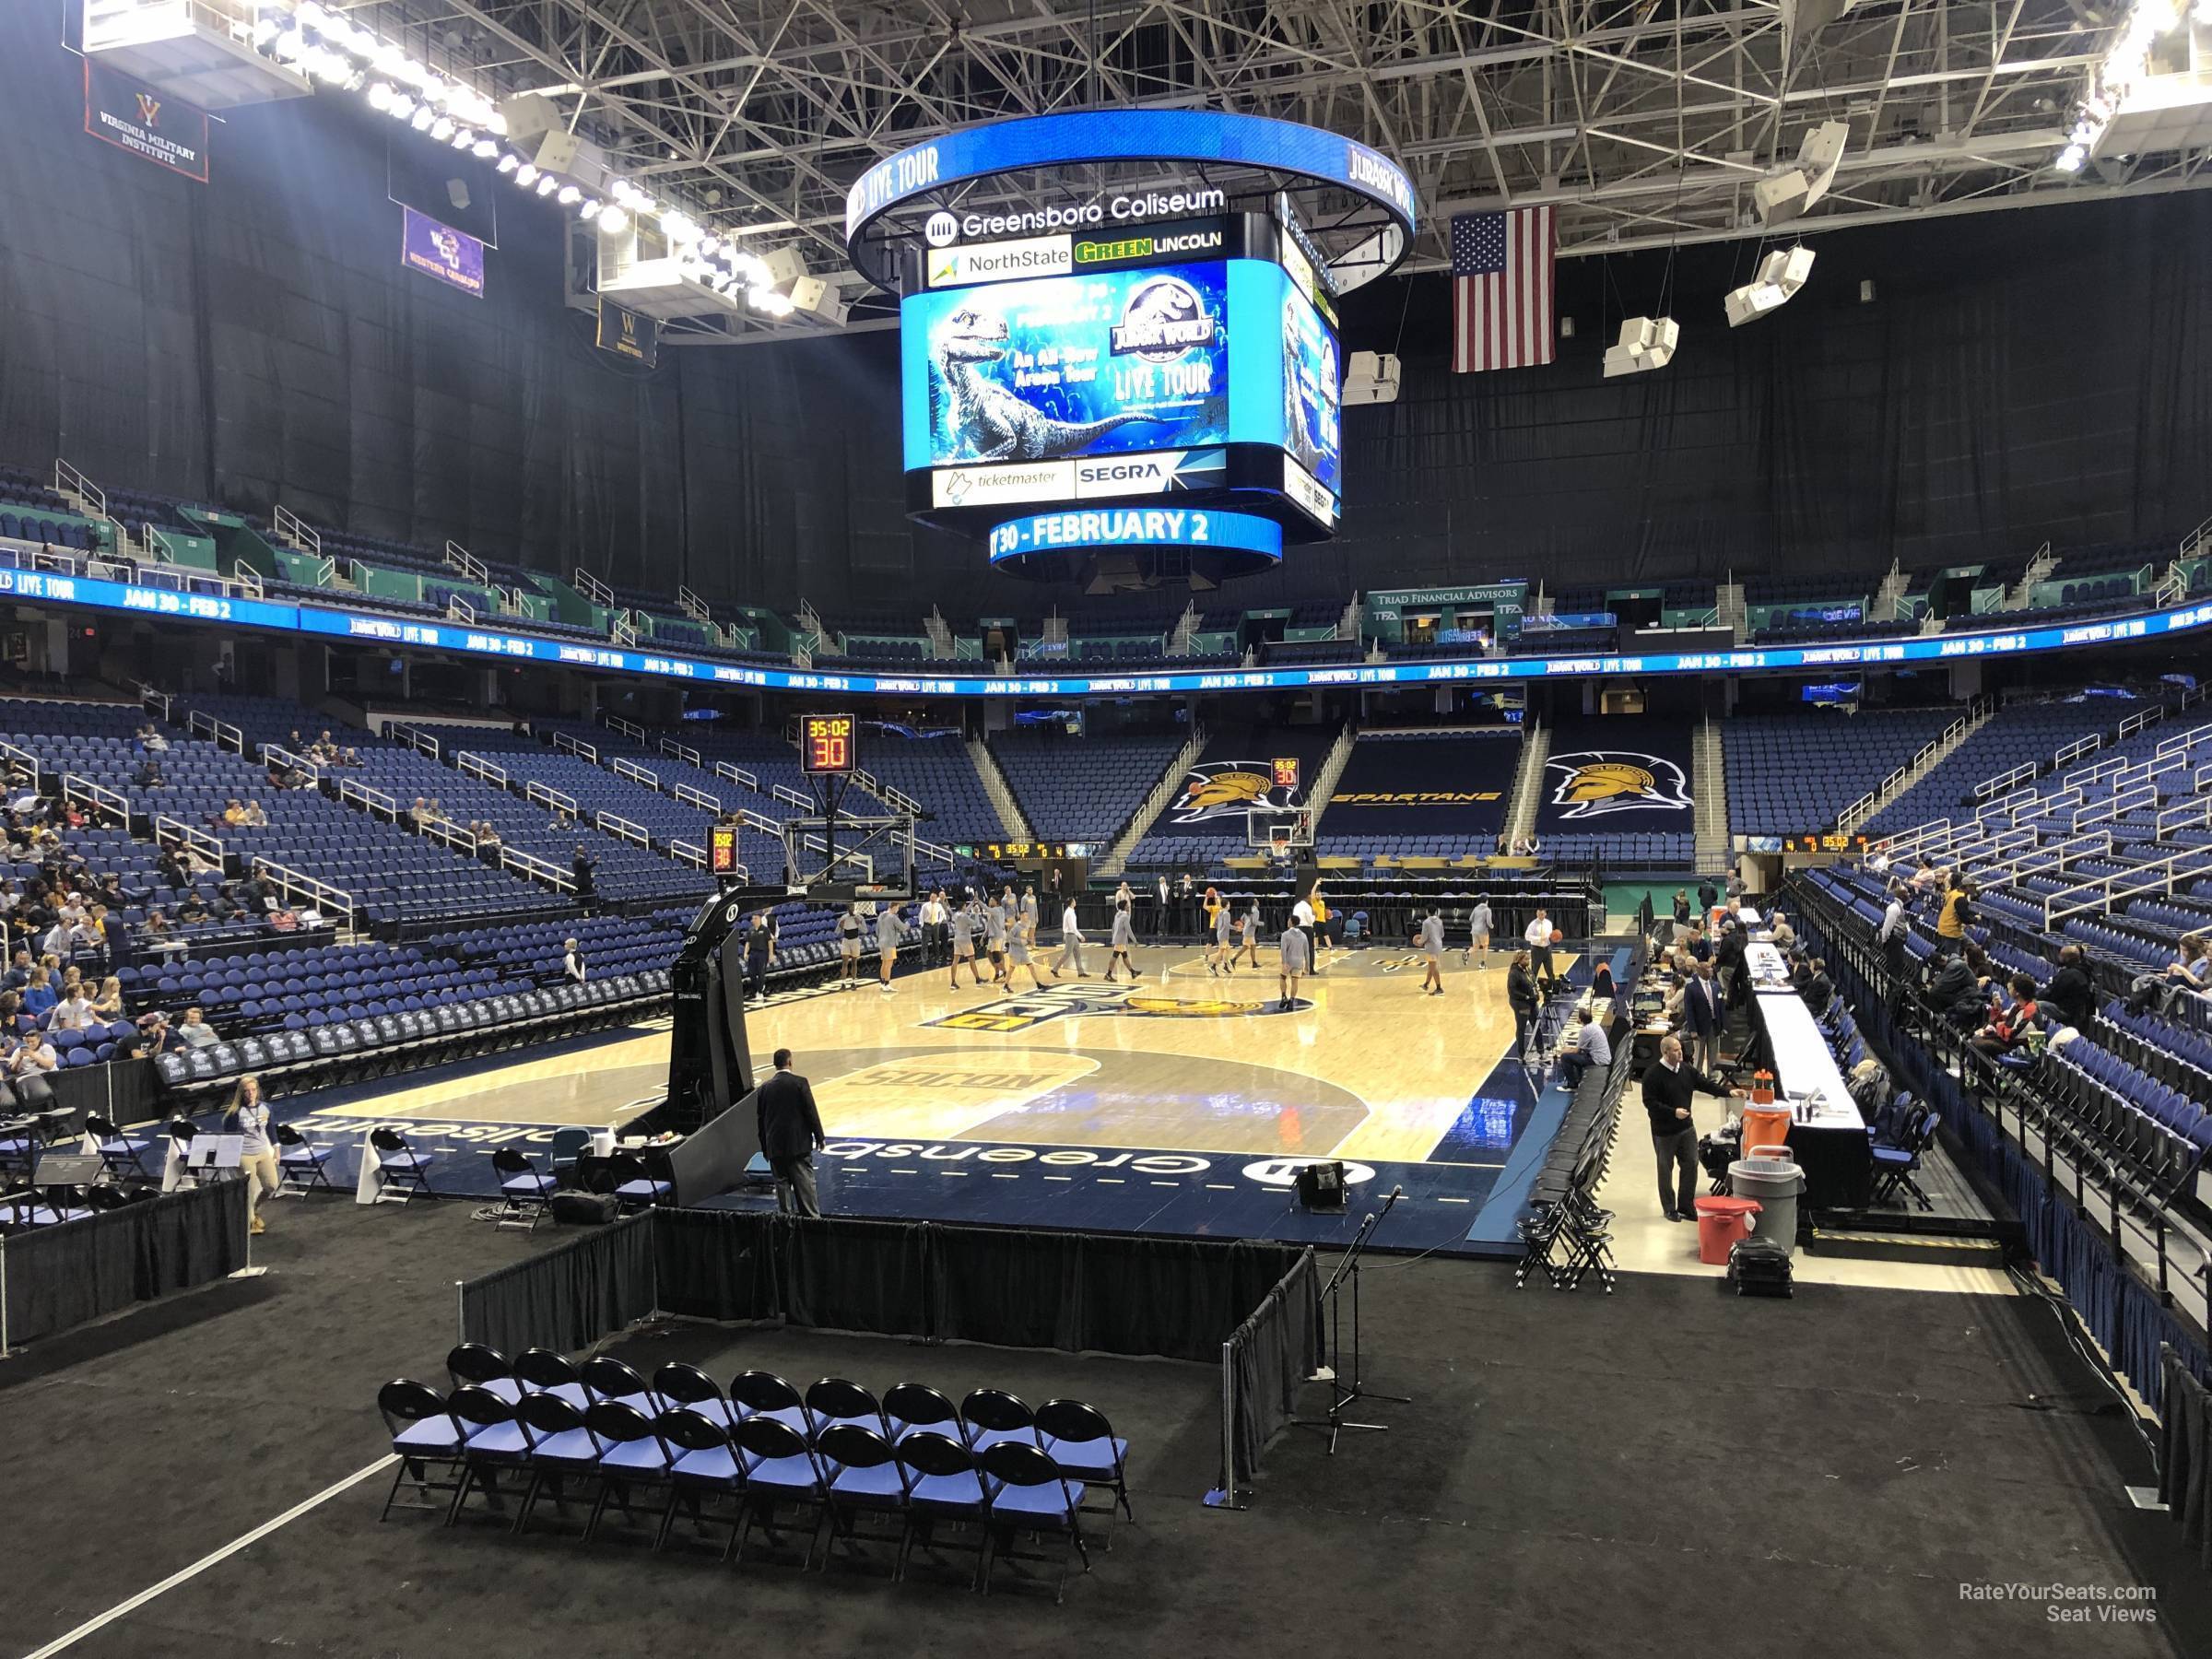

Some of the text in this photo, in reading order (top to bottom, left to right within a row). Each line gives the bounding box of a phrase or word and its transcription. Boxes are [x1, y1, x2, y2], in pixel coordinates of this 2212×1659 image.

[100, 112, 195, 160] VIRGINIA MILITARY
[122, 134, 175, 164] INSTITUTE
[868, 164, 894, 210] LIVE
[897, 147, 939, 194] TOUR
[963, 189, 1224, 237] Greensboro Coliseum
[1075, 231, 1222, 263] GREEN LINCOLN
[970, 247, 1069, 272] NorthState
[1162, 319, 1212, 346] WORLD
[1114, 363, 1211, 401] LIVE TOUR
[978, 471, 1057, 488] ticketmaster
[1080, 464, 1161, 482] SEGRA
[998, 528, 1018, 553] 30
[1033, 512, 1185, 545] FEBRUARY
[1191, 514, 1208, 541] 2
[18, 575, 42, 595] LIVE
[47, 578, 75, 599] TOUR
[124, 589, 230, 618] JAN 30 FEB 2
[1378, 589, 1518, 606] TRIAD FINANCIAL ADVISORS
[1372, 611, 1399, 621] TFA
[1496, 604, 1524, 615] TFA
[466, 634, 533, 655] JAN 30 FEB 2
[1940, 636, 2027, 655] JAN 30 FEB 2
[1677, 654, 1765, 669] JAN 30 FEB 2
[1831, 649, 1860, 663] WORLD
[1864, 648, 1881, 661] LIVE
[1883, 646, 1905, 659] TOUR
[1429, 665, 1509, 678] JAN 30 FEB 2
[1573, 661, 1601, 673] WORLD
[1603, 660, 1620, 672] LIVE
[1622, 659, 1642, 671] TOUR
[788, 676, 849, 689] JAN 30 FEB 2
[983, 682, 1058, 693] JAN 30 FEB 2
[1200, 675, 1274, 688] JAN 30 FEB 2
[810, 721, 850, 736] 35:02
[816, 738, 845, 766] 30
[1275, 761, 1296, 770] 35:02
[1277, 770, 1294, 783] 30
[1330, 793, 1502, 802] SPARTANS
[715, 833, 732, 847] 35:02
[1006, 844, 1030, 853] 35:02
[1787, 841, 1794, 851] 4
[1823, 837, 1848, 847] 35:02
[716, 849, 730, 865] 30
[787, 886, 807, 895] SPALDING
[845, 1070, 1062, 1090] SOCON
[821, 1142, 1210, 1174] Greensb
